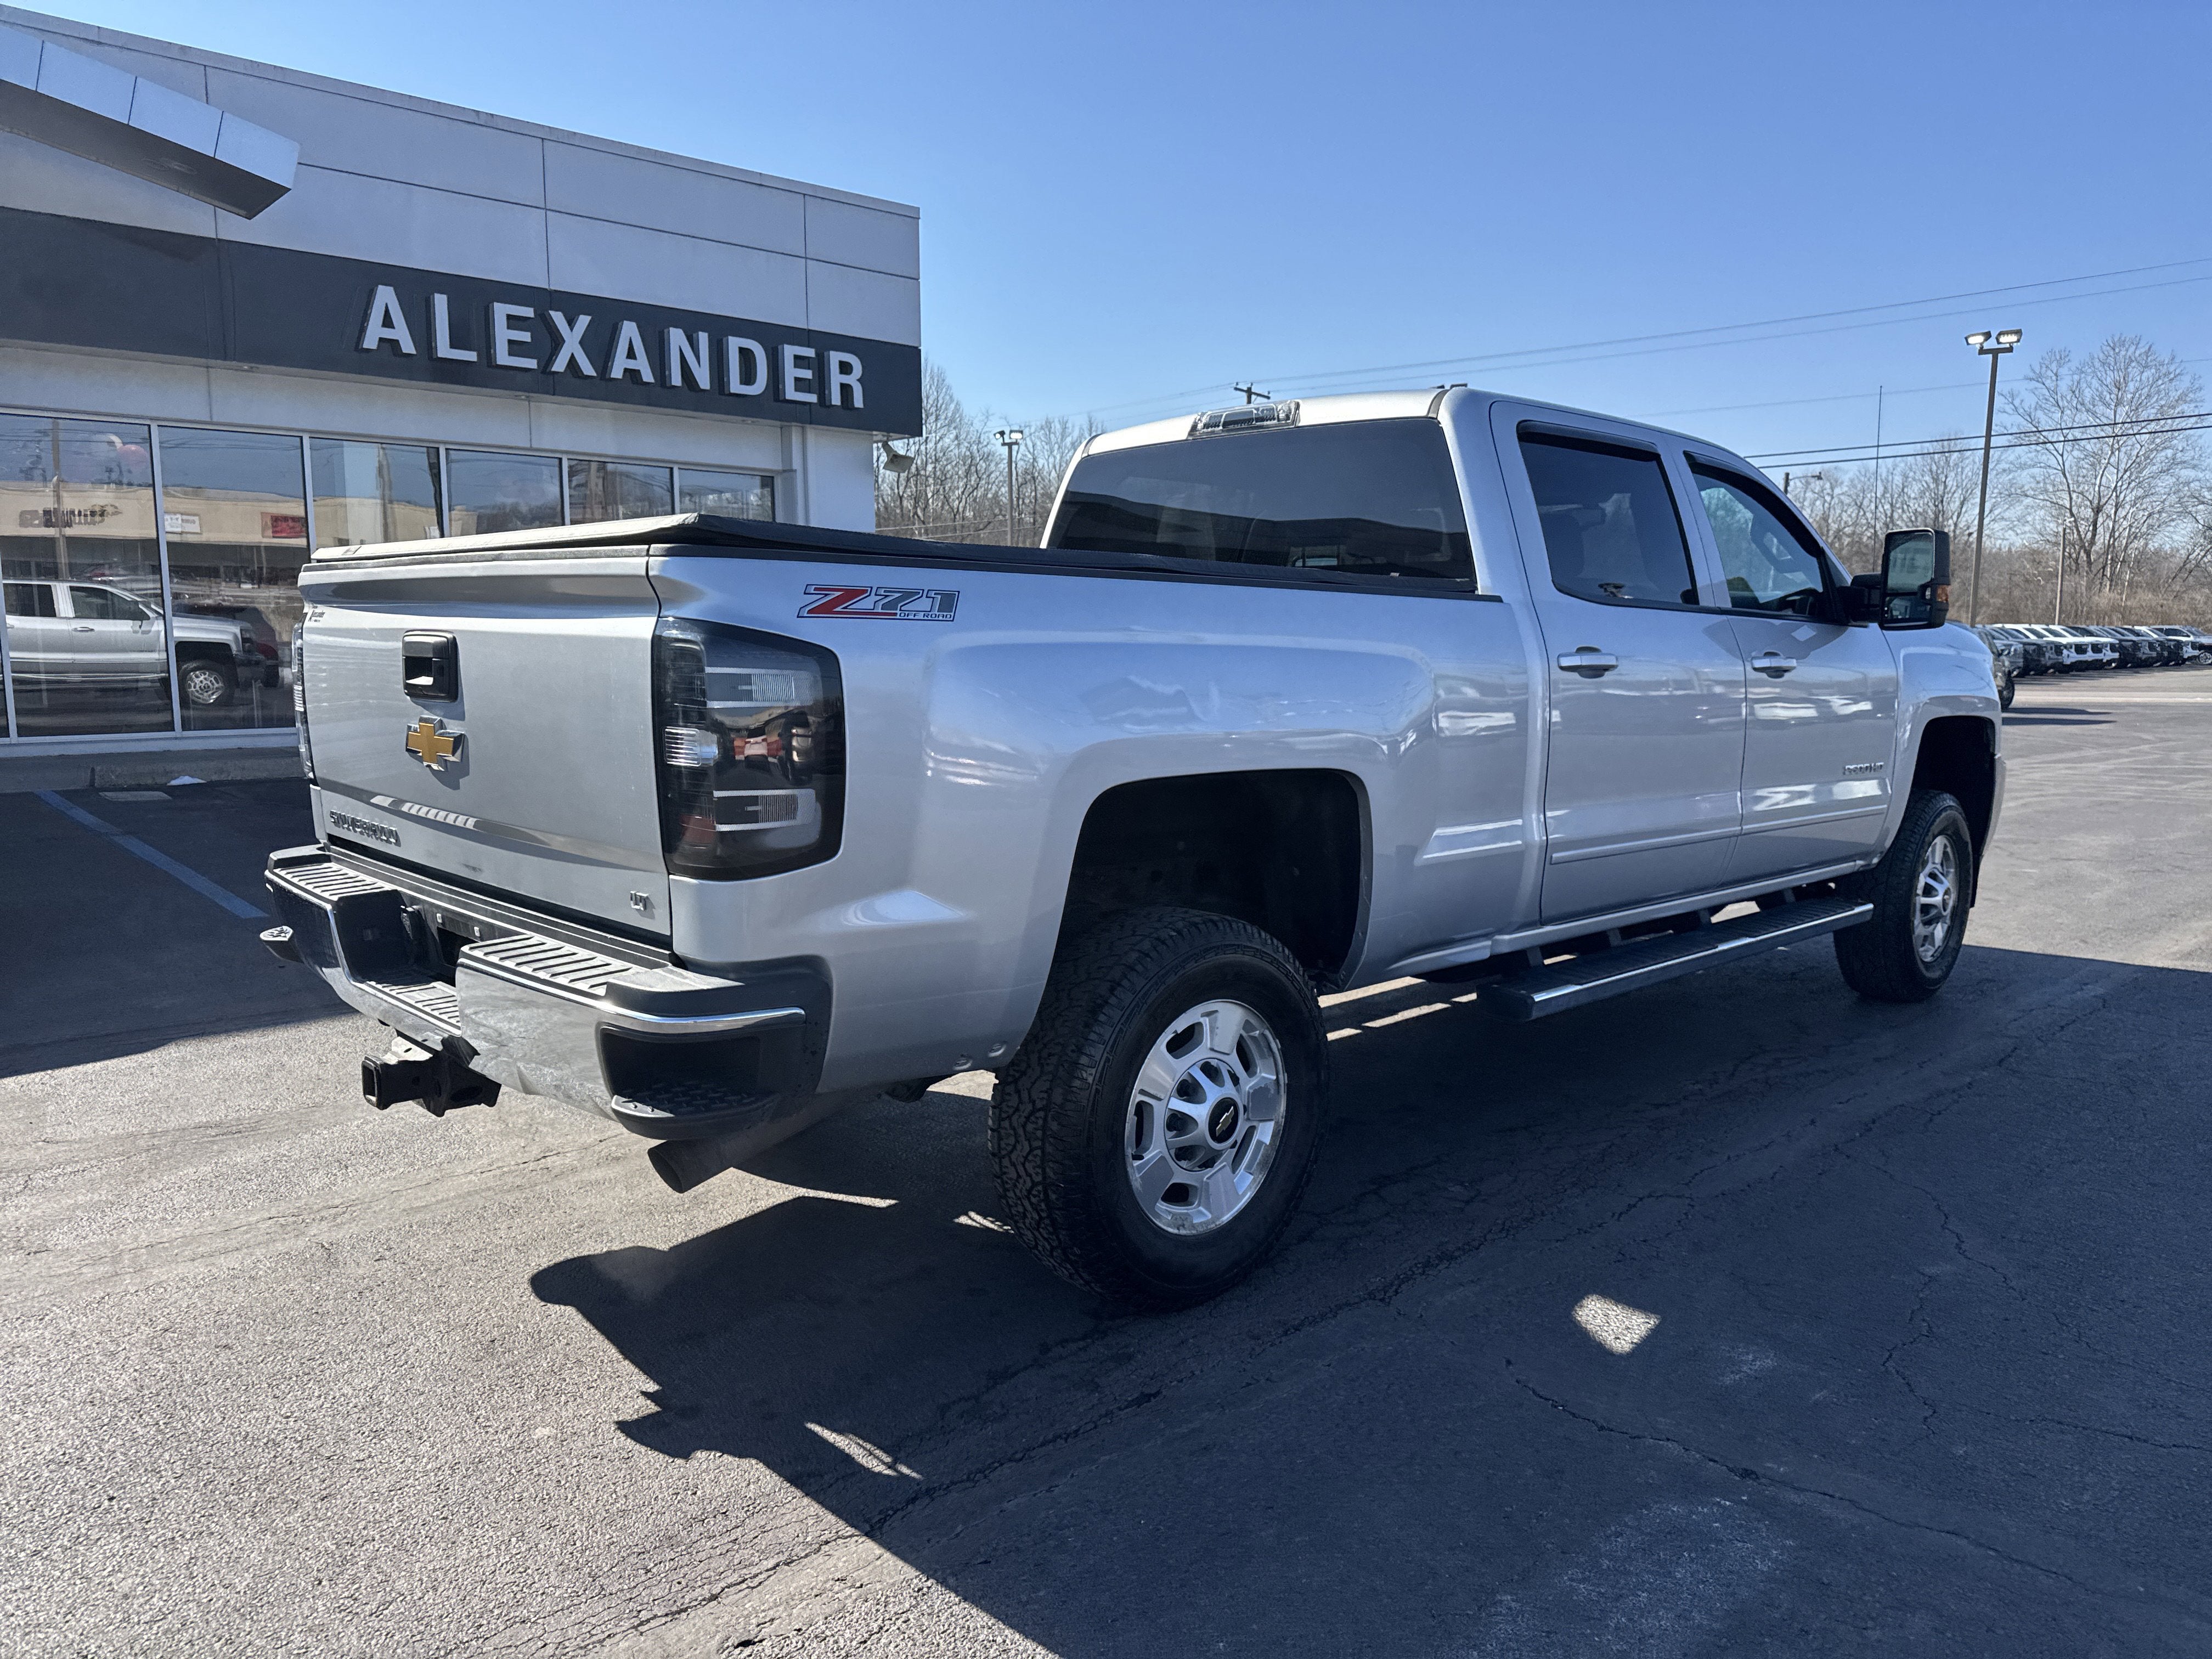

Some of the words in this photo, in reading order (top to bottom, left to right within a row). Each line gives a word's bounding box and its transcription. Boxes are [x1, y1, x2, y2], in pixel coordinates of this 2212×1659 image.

[360, 285, 865, 409] ALEXANDER
[797, 584, 960, 621] Z71
[630, 890, 648, 911] LT
